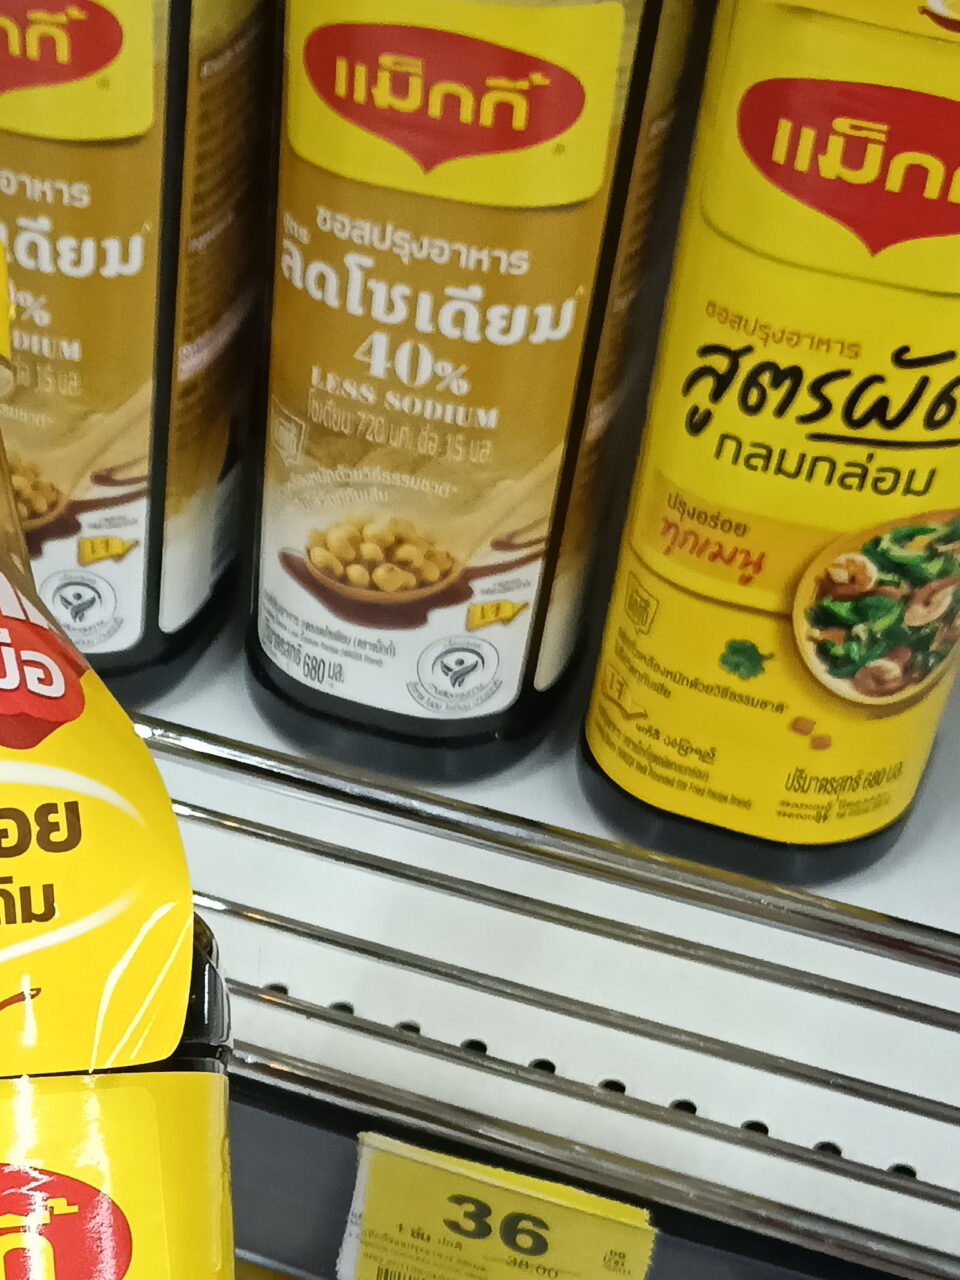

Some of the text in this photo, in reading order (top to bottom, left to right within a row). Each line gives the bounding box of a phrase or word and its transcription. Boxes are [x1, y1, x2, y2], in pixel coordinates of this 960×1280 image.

[334, 53, 551, 131] แม็กกี้
[771, 117, 960, 205] แม็ก
[316, 205, 530, 277] ซอสปรุงอาหาร
[310, 365, 376, 404] LESS
[353, 331, 471, 396] 40%
[713, 432, 938, 498] กลมกล่อม
[442, 1193, 551, 1258] 36
